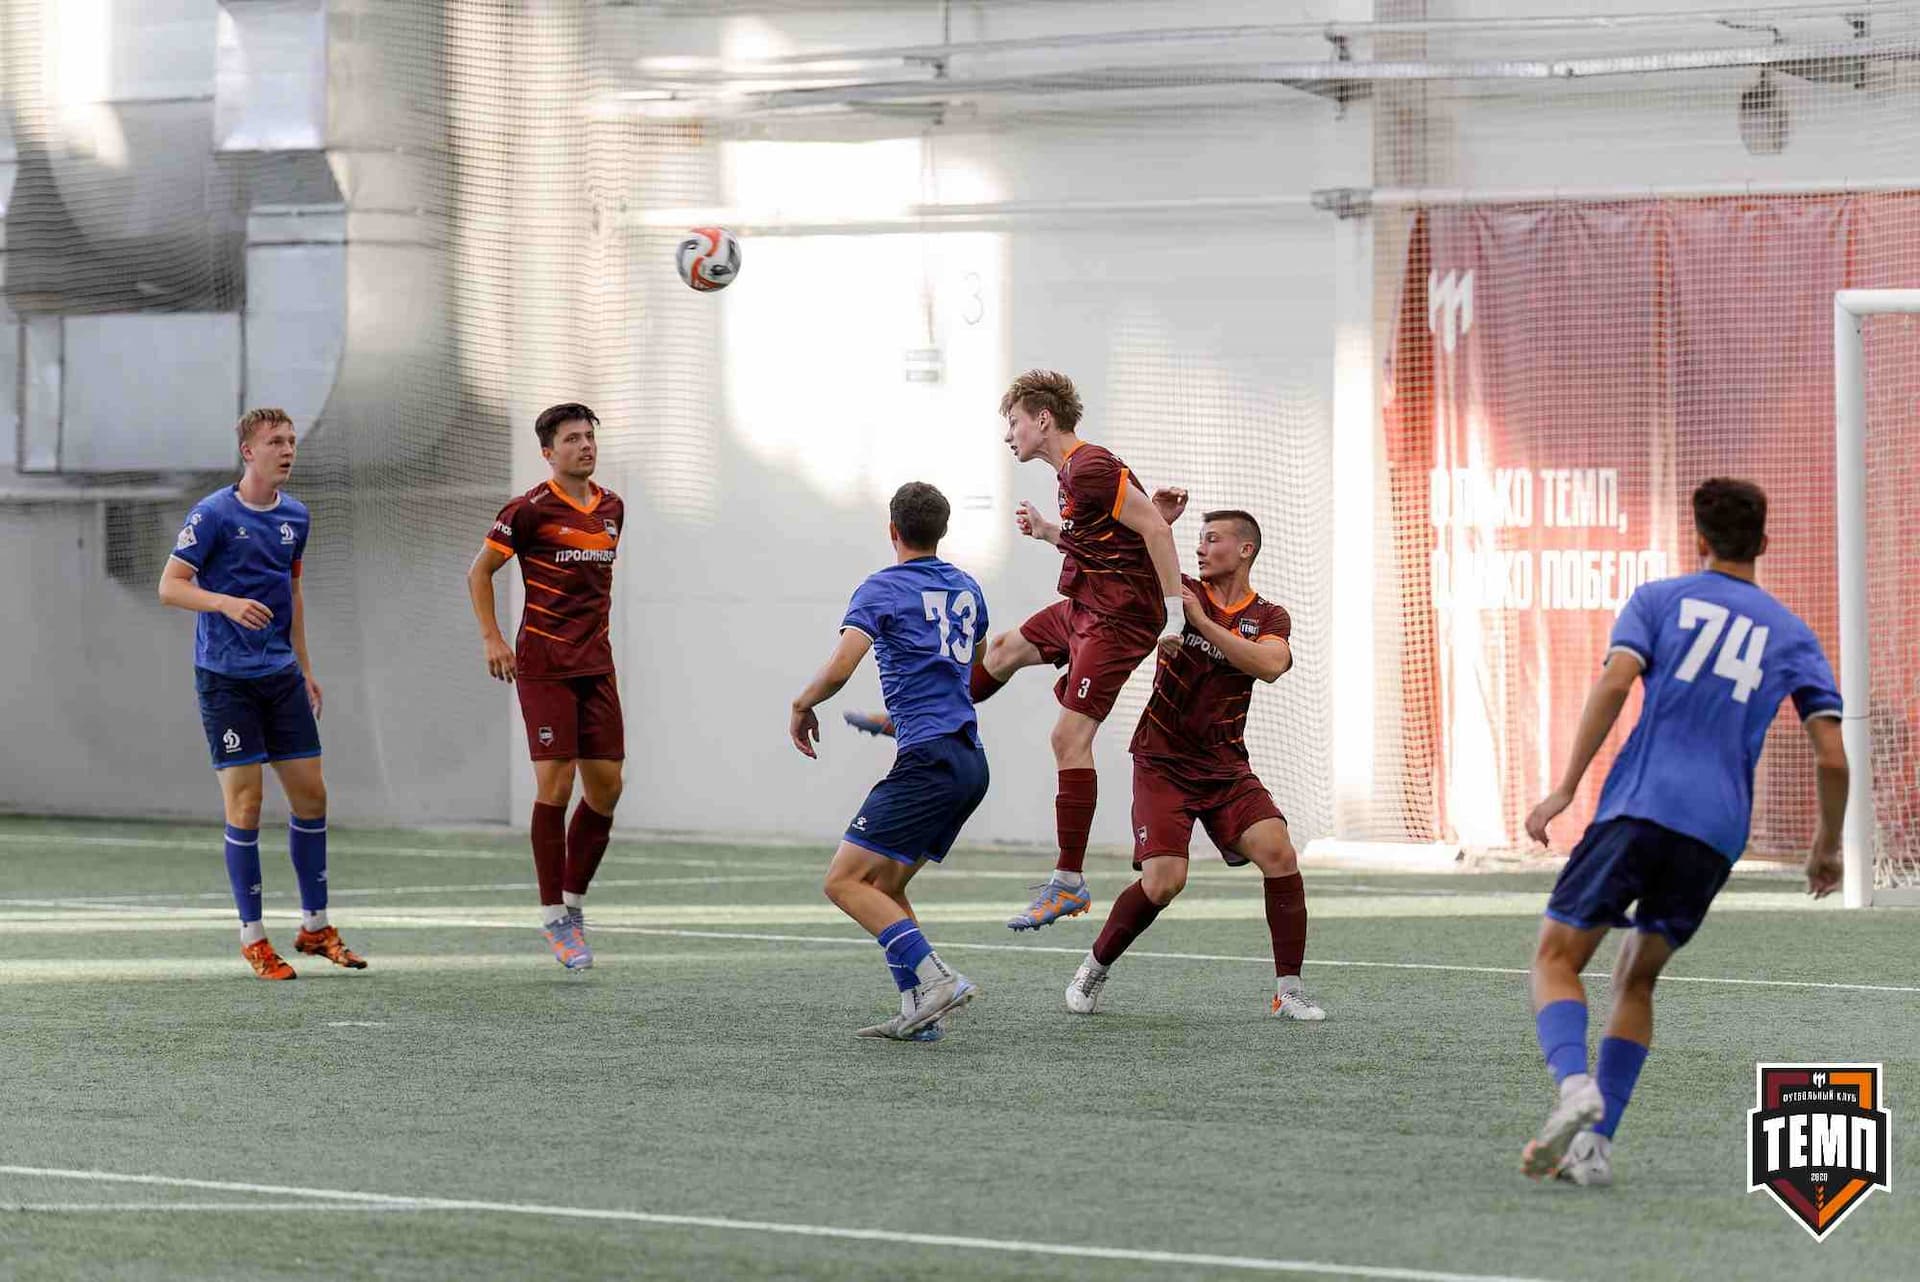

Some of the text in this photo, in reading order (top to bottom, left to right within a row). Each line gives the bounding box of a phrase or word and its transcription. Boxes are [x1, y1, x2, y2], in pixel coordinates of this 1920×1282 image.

[1540, 468, 1628, 534] ТЕМП,
[920, 590, 978, 664] 73
[1674, 597, 1769, 704] 74
[1077, 677, 1091, 699] 3
